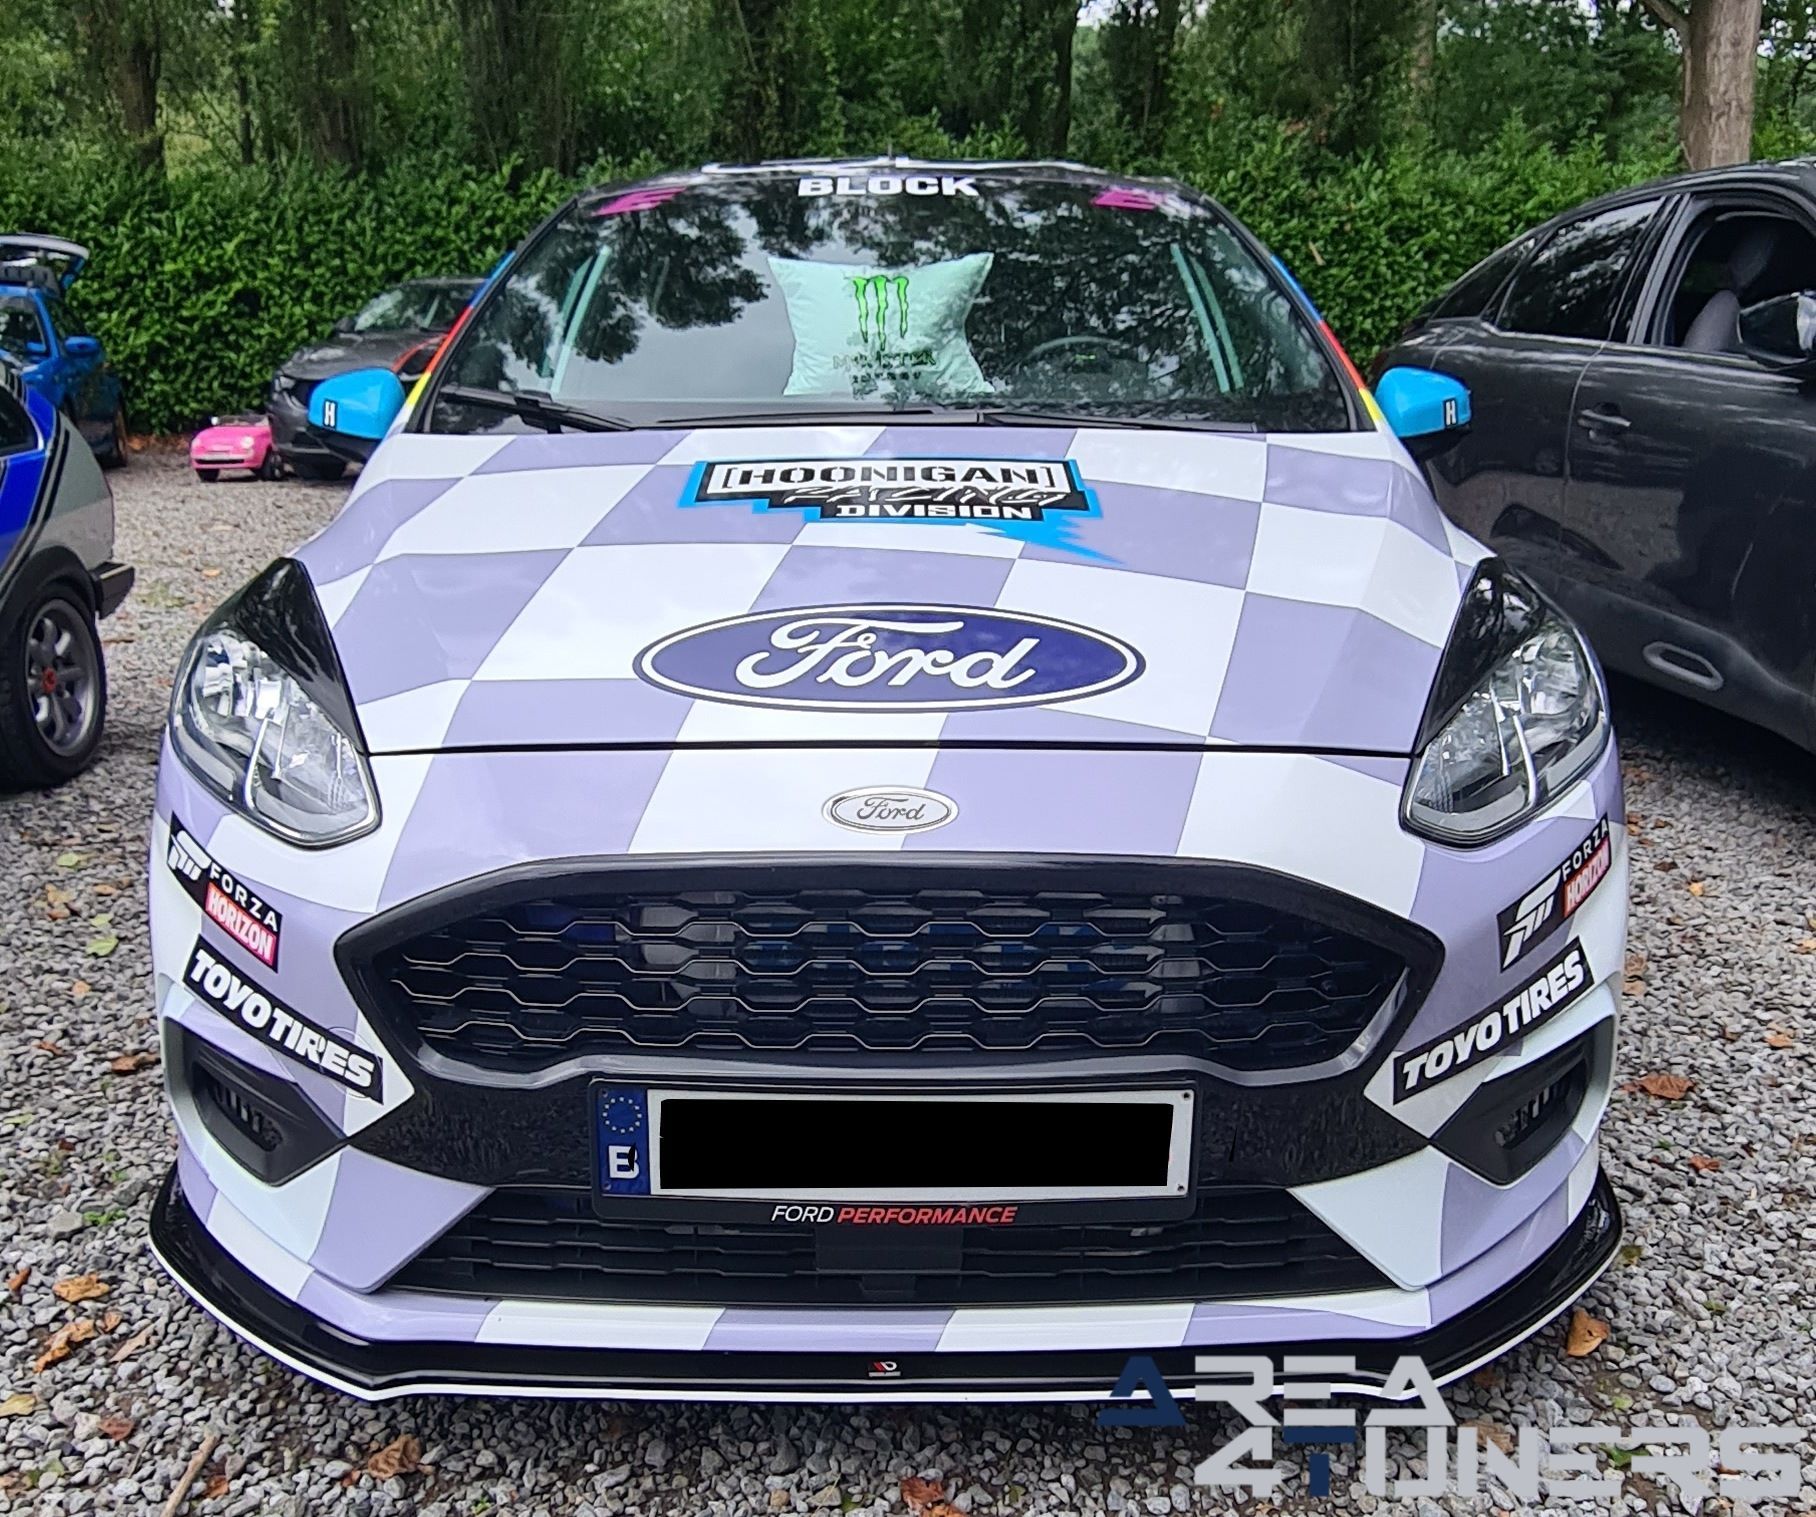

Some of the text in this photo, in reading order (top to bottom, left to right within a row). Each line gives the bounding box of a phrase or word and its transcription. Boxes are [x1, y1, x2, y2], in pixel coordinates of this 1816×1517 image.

[798, 176, 979, 197] BLOCK
[324, 400, 336, 427] H
[1445, 400, 1457, 426] H
[836, 504, 1032, 519] DIVISION
[735, 617, 1040, 689] Ford
[856, 797, 925, 820] Ford
[1562, 822, 1609, 882] FORZA
[209, 861, 278, 932] FORZA
[209, 889, 273, 961] HORIZON
[190, 949, 375, 1087] TOYO TIRES
[1403, 950, 1584, 1090] TOYO TIRES
[608, 1145, 640, 1179] B
[771, 1205, 1018, 1224] FORD PERFORMANCE
